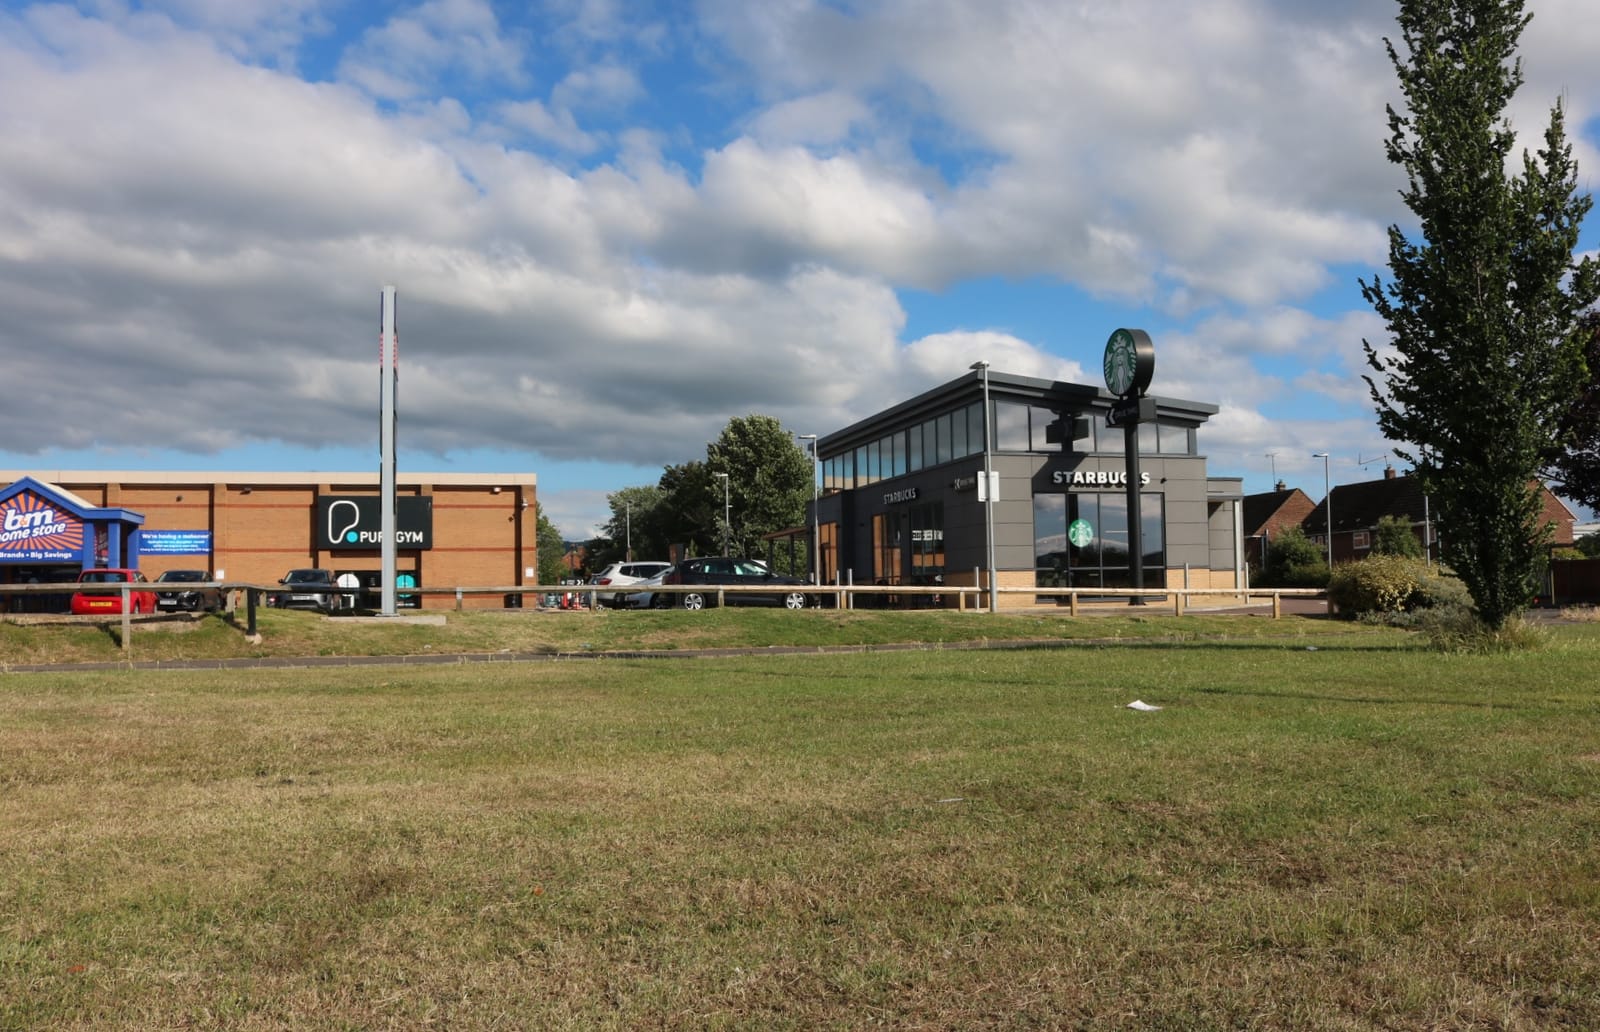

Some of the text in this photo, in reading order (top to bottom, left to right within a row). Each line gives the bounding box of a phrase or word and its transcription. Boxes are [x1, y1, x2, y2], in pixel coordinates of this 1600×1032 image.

[1053, 471, 1151, 485] STARBUCS
[883, 487, 917, 505] STARBUCKS
[0, 522, 66, 542] ome store
[360, 531, 424, 543] PURGYM
[30, 551, 43, 560] Big
[44, 551, 73, 559] Savings
